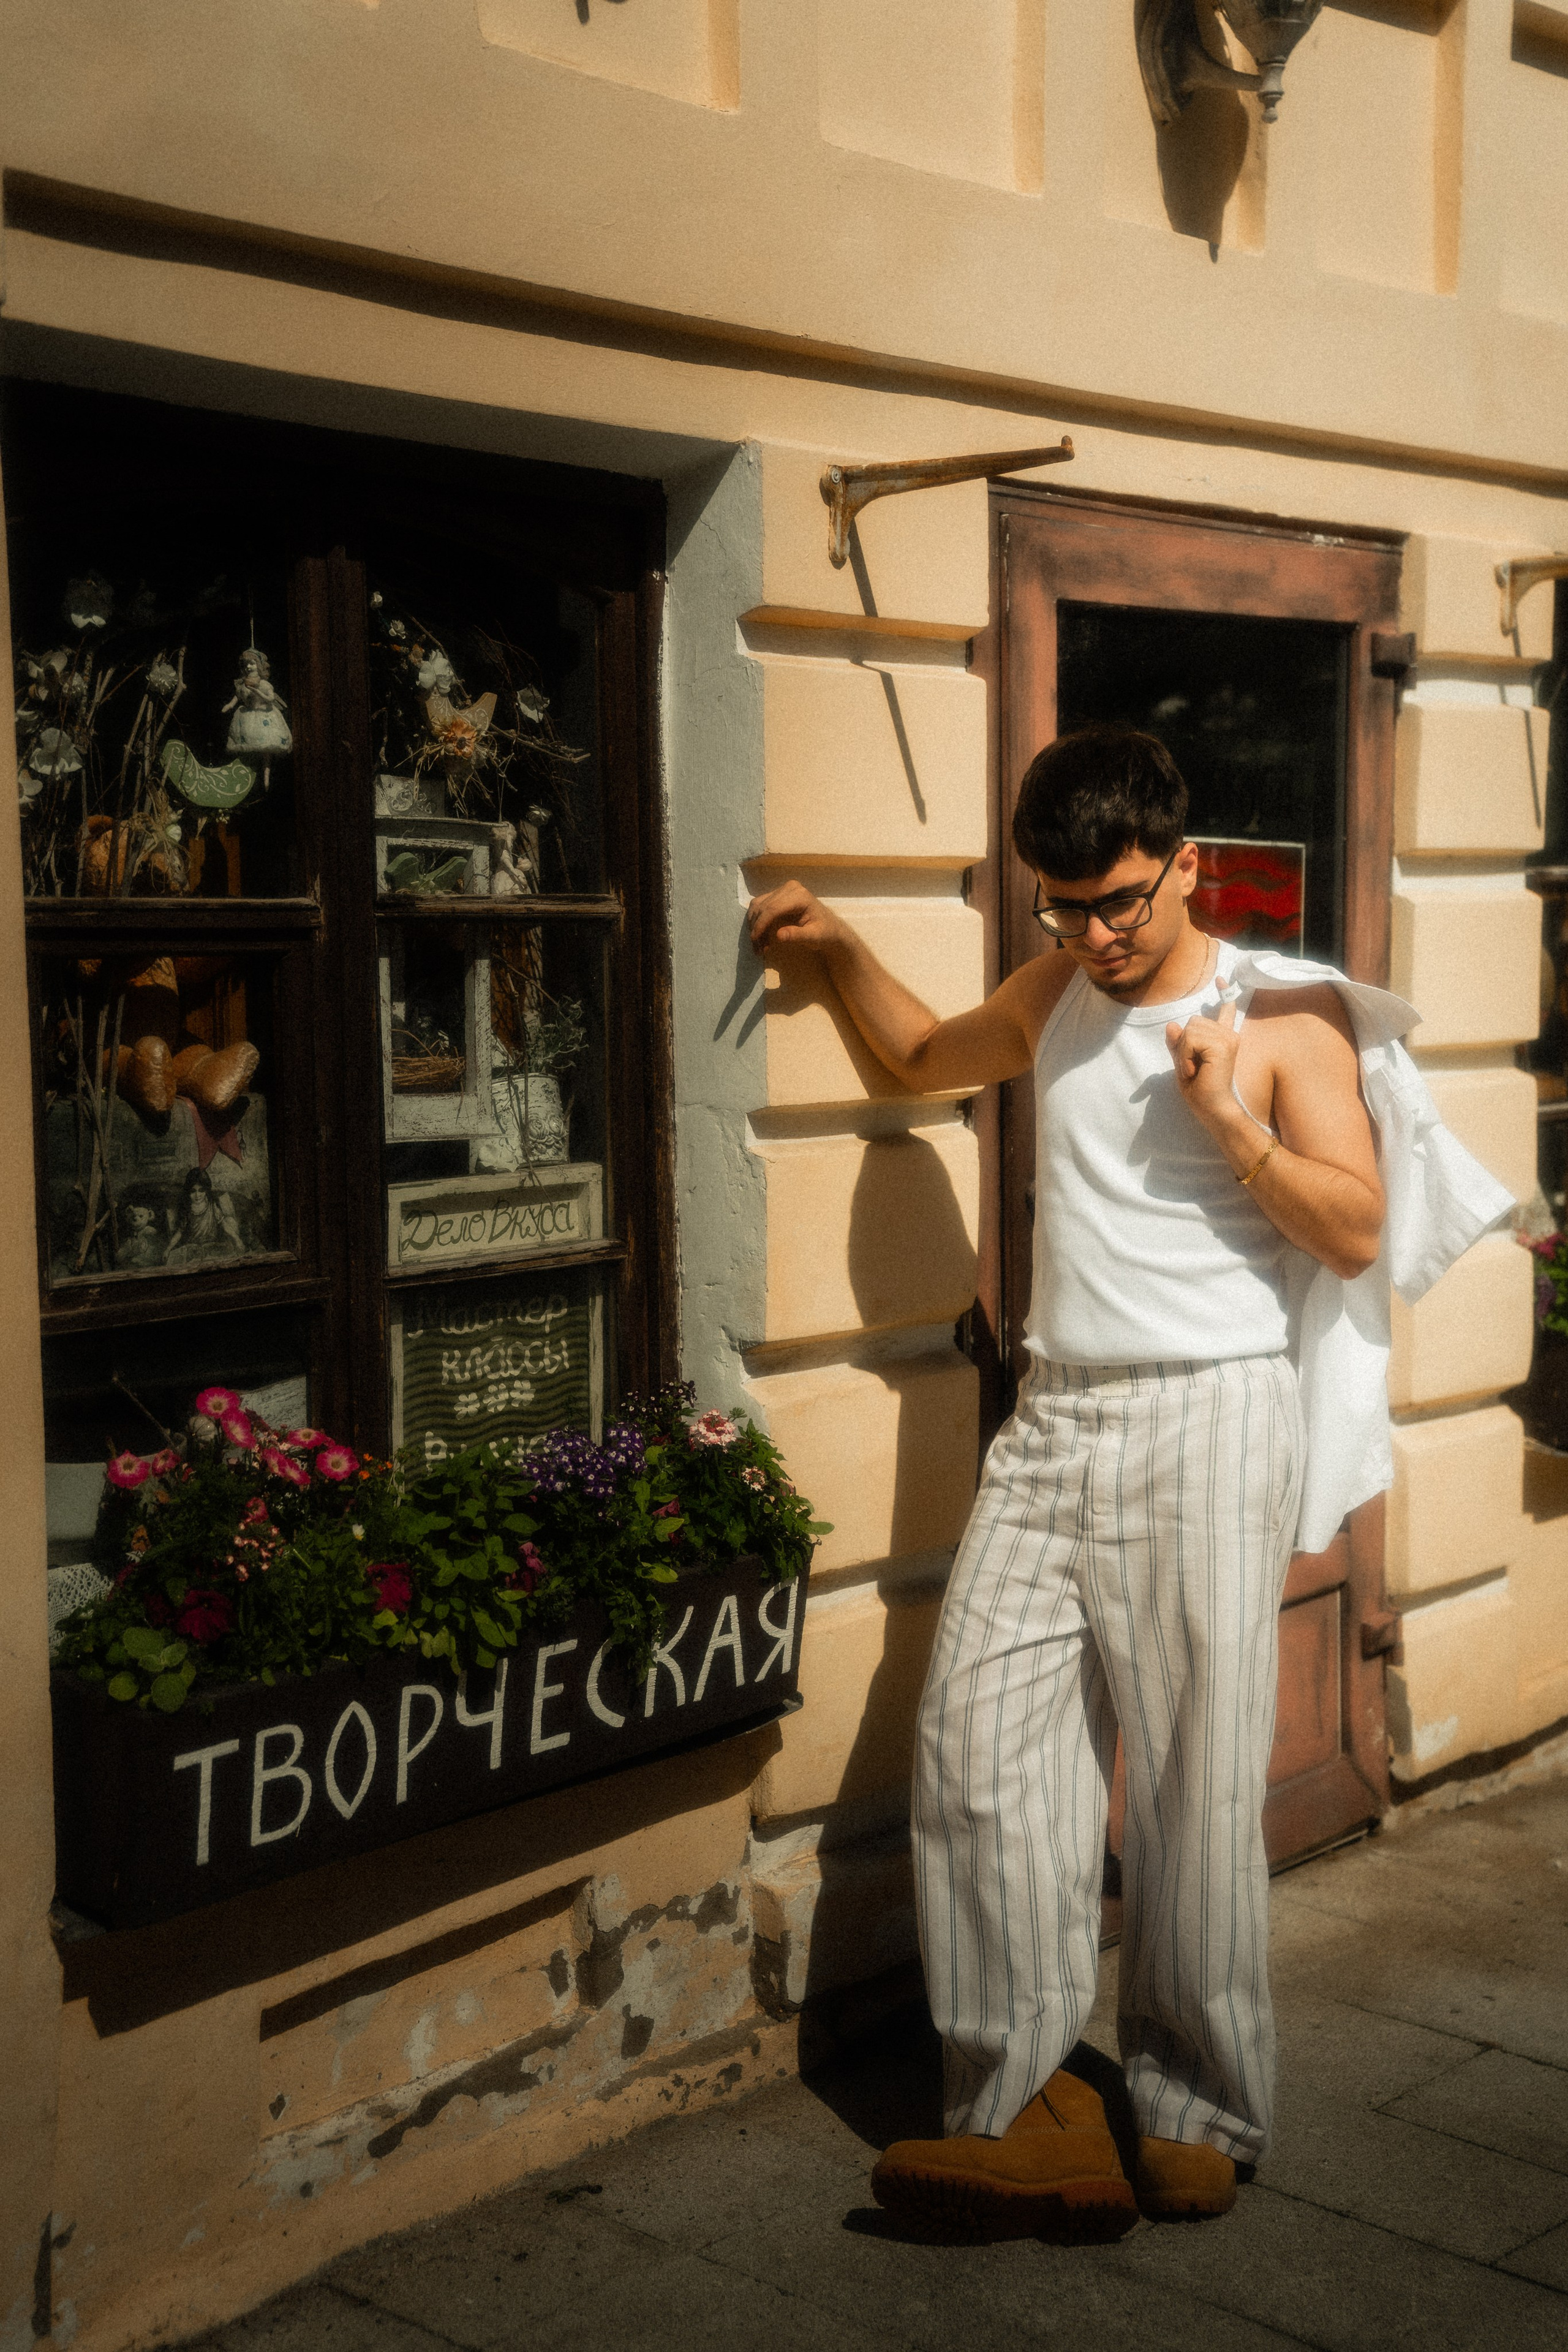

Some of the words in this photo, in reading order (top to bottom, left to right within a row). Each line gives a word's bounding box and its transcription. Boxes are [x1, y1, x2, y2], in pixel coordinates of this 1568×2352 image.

[402, 1209, 486, 1251] Дело
[488, 1199, 575, 1244] Вкуса
[173, 1575, 799, 1866] ТВОРЧЕСКАЯ
